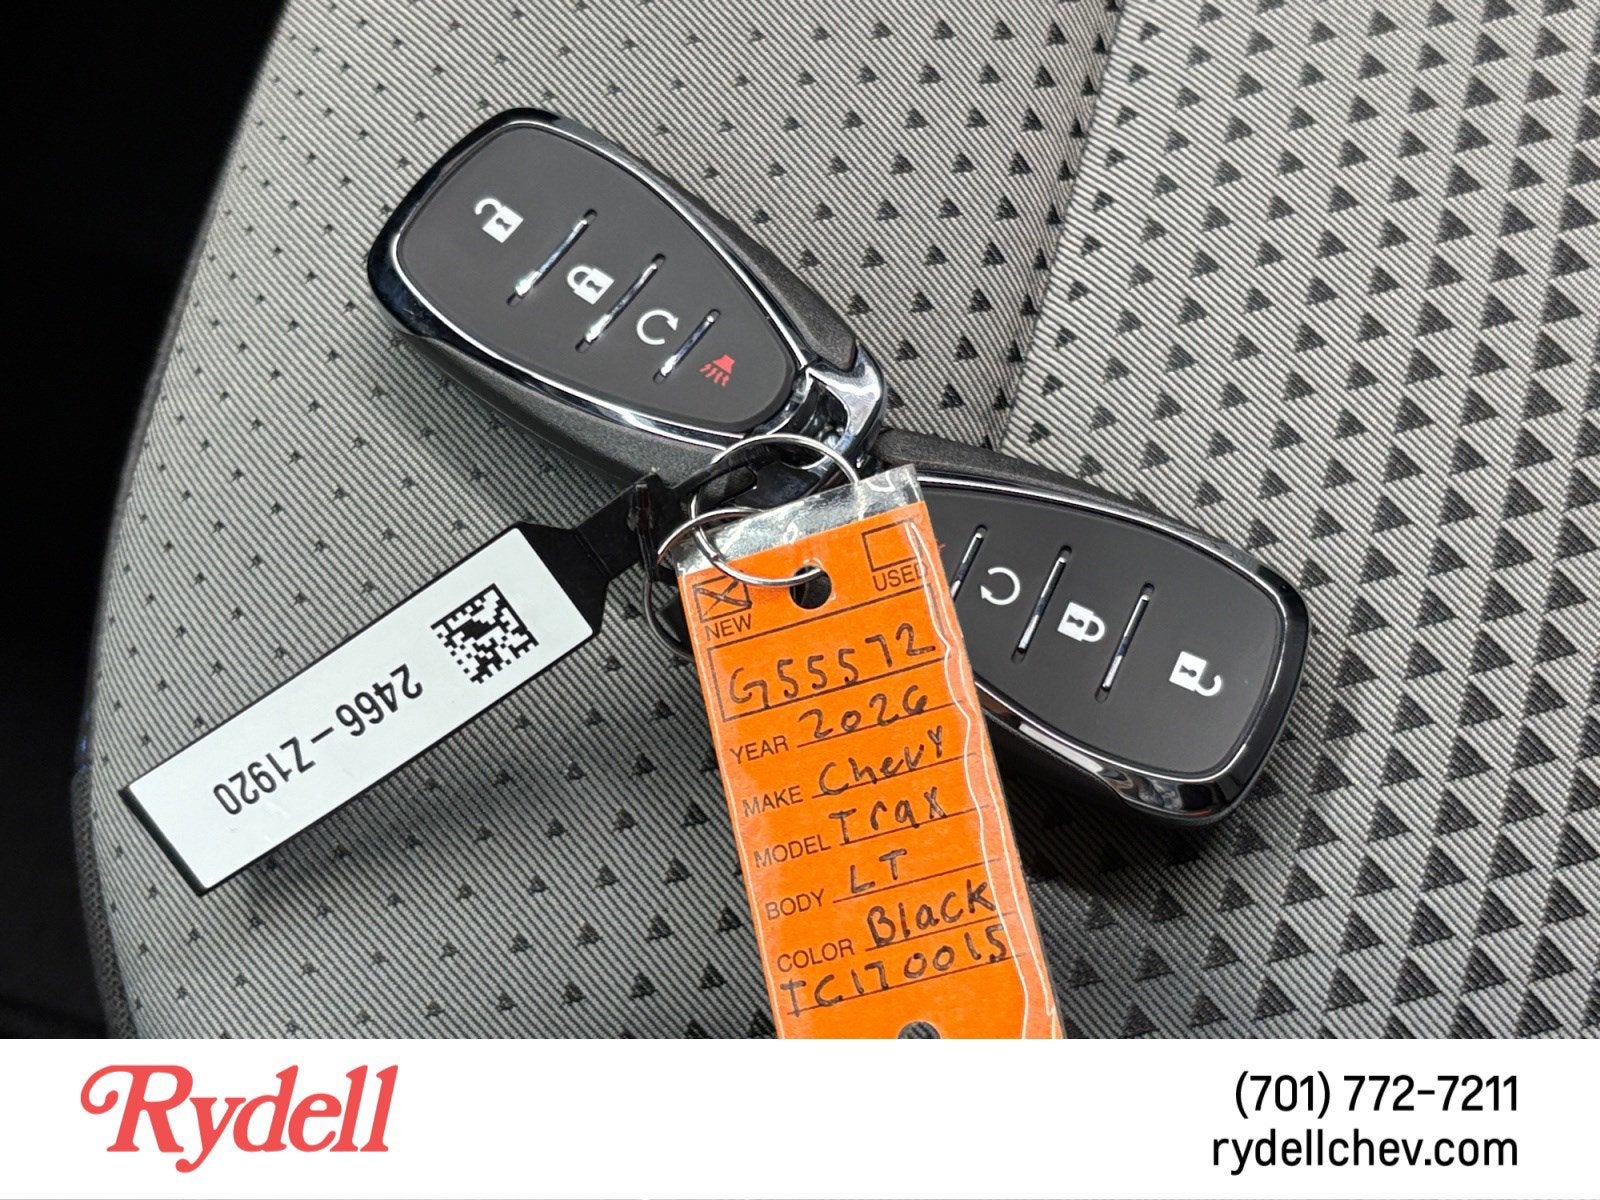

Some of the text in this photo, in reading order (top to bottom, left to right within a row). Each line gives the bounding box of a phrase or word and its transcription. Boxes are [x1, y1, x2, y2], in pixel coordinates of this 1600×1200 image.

[873, 562, 928, 592] USED
[704, 614, 753, 641] NEW
[728, 622, 936, 710] G55572
[730, 735, 790, 765] YEAR
[741, 787, 804, 817] MAKE
[753, 834, 831, 868] MODEL
[849, 848, 907, 895] LT
[765, 889, 825, 920] BODY
[776, 939, 855, 973] COLOR
